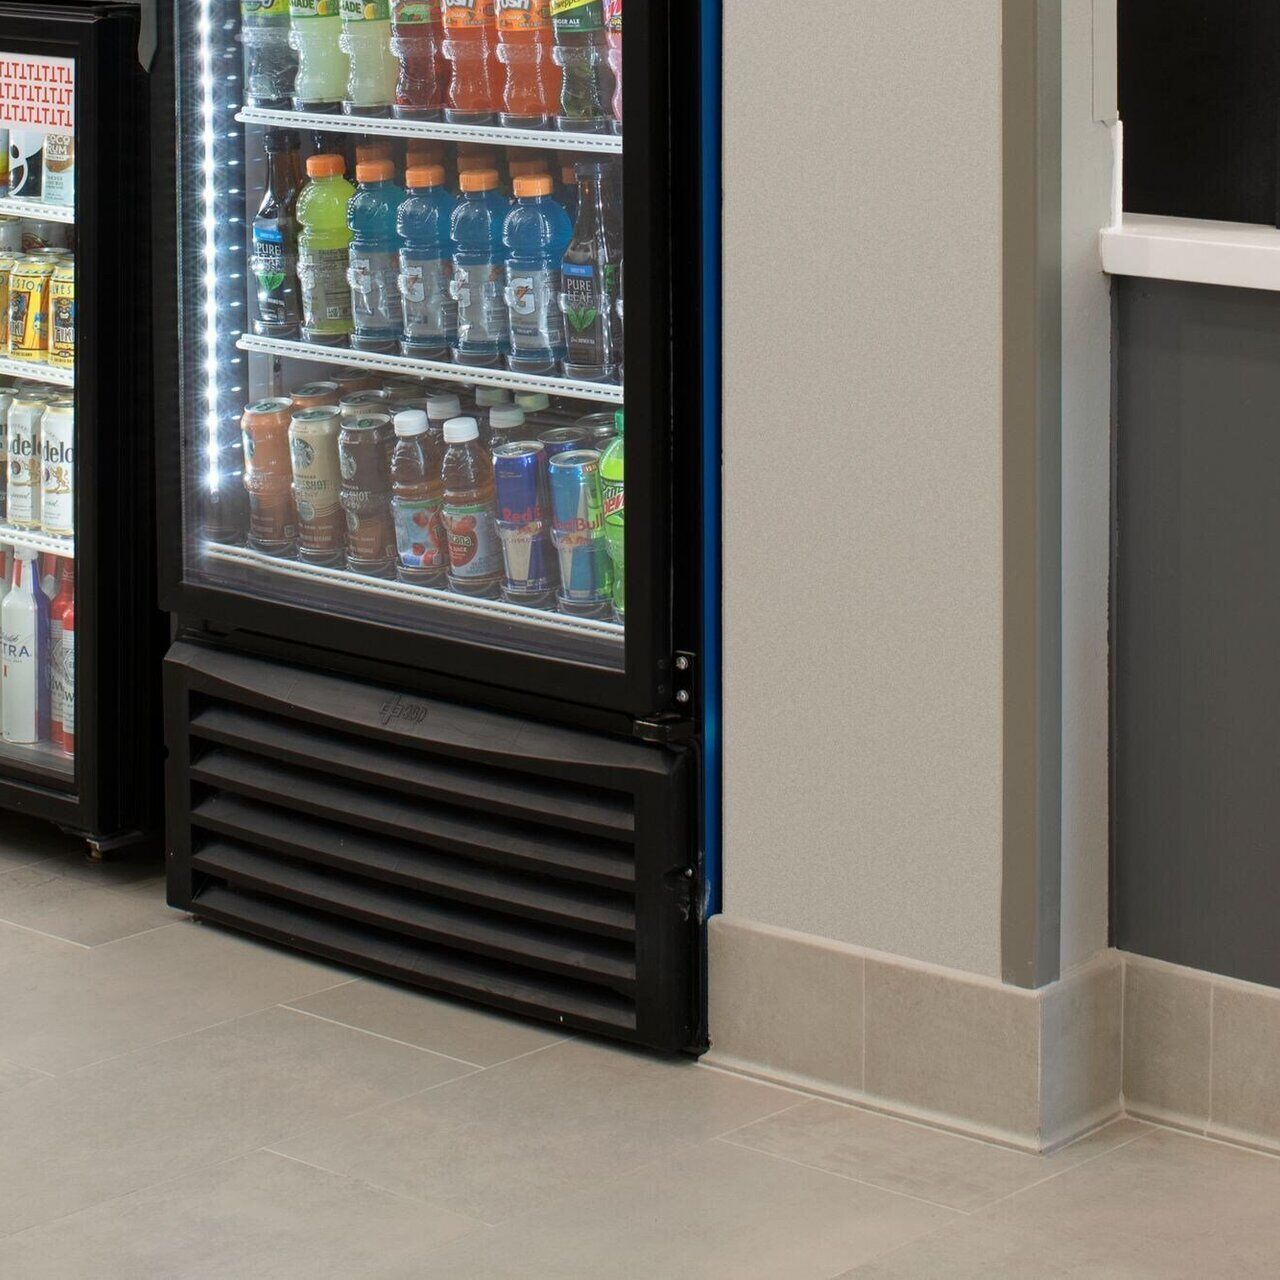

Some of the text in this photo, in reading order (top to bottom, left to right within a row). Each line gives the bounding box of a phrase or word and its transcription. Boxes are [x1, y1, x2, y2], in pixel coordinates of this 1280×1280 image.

[256, 243, 281, 255] PURE
[567, 279, 592, 291] PURE
[568, 291, 592, 302] LEAF
